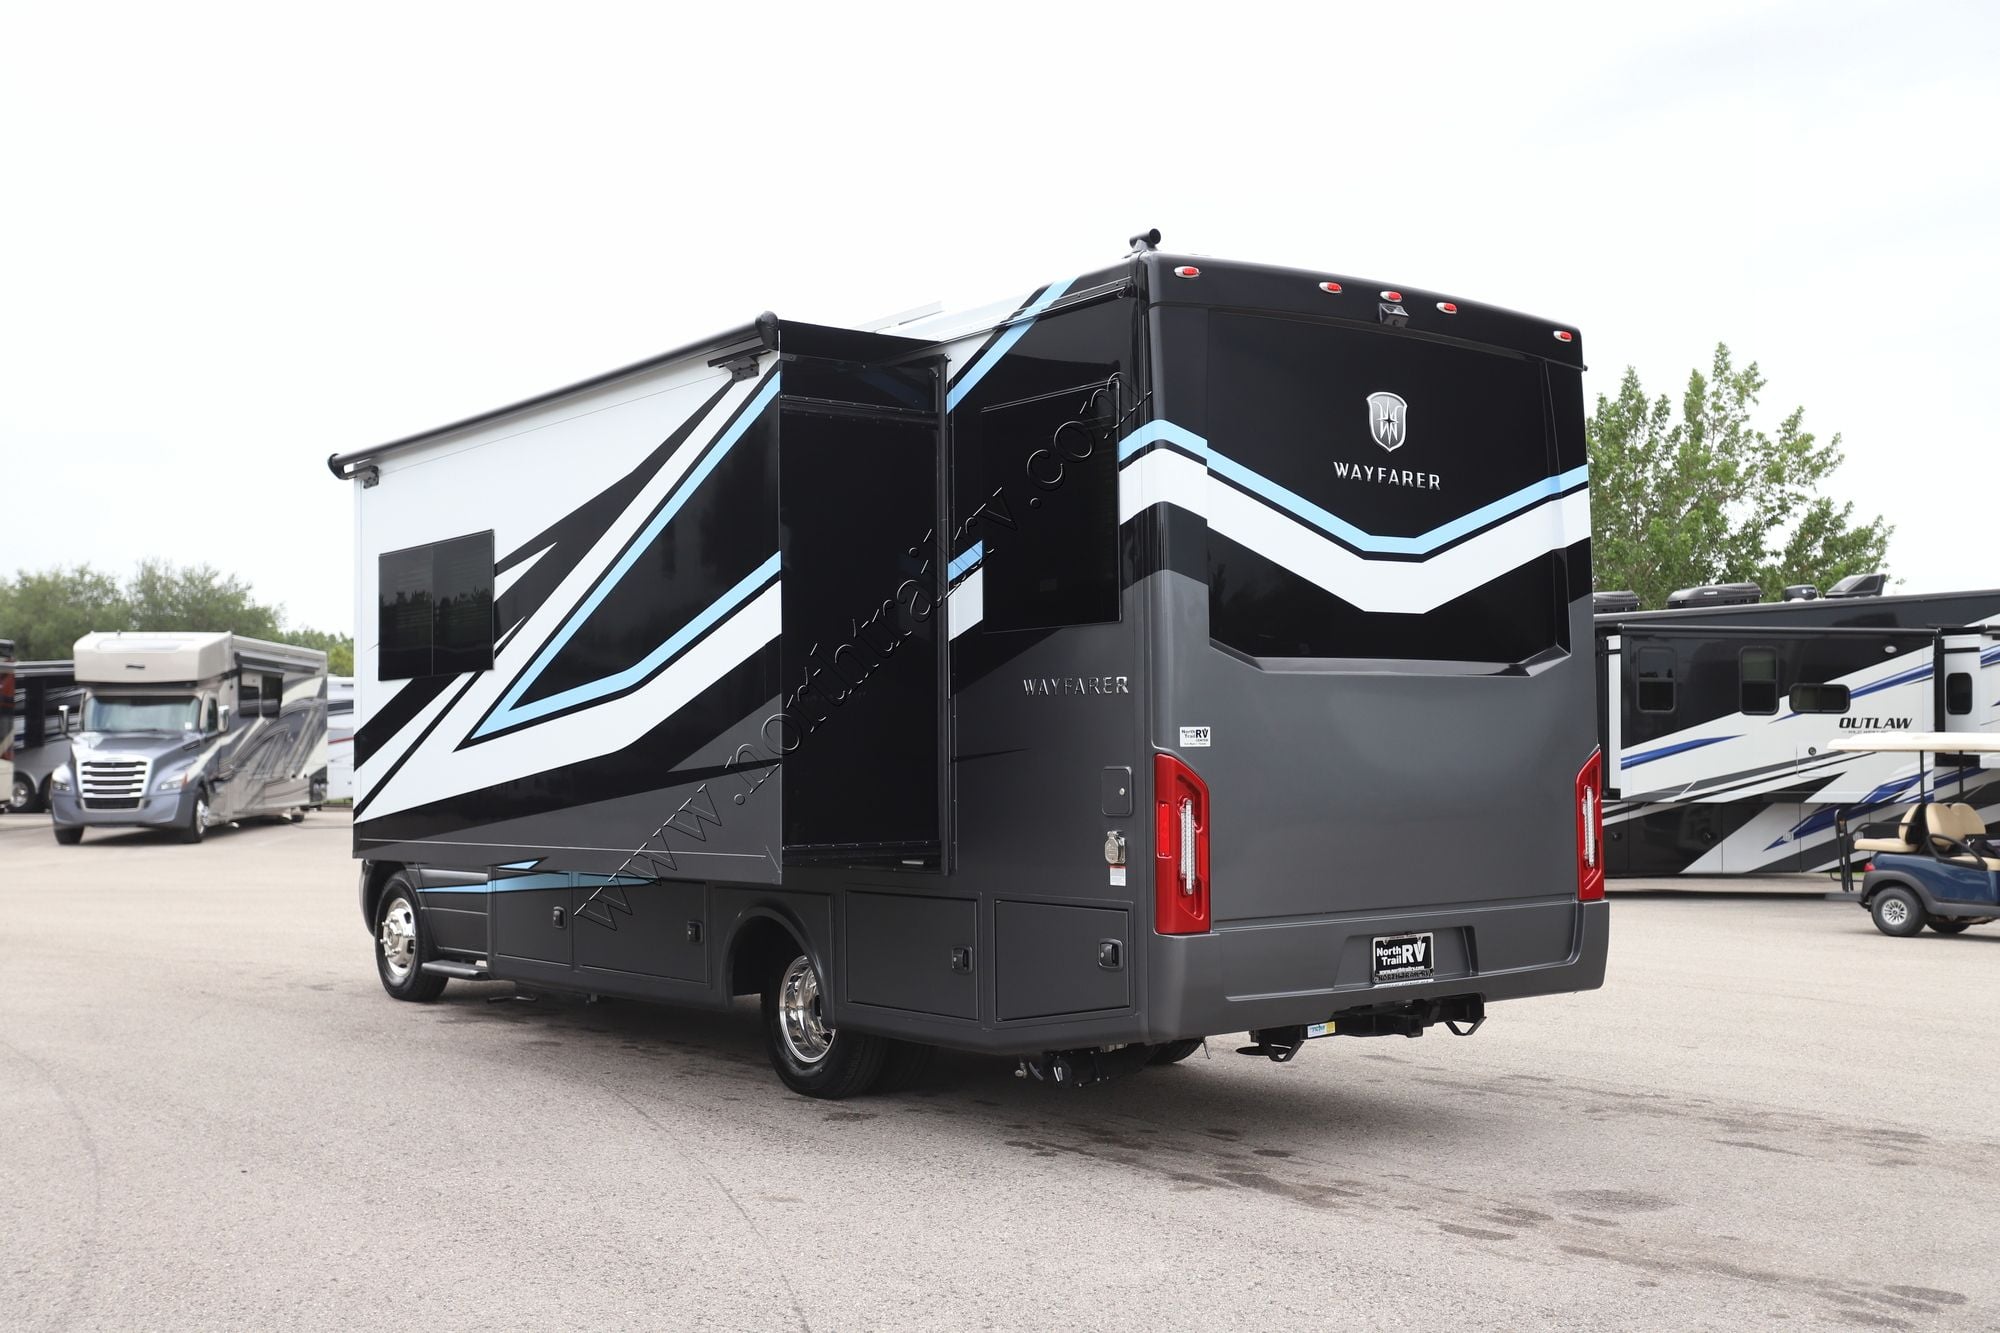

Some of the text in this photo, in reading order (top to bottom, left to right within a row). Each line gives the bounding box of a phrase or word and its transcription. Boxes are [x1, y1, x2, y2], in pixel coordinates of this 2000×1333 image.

[1333, 461, 1441, 491] WAYFARER
[1023, 676, 1129, 696] WAYFARER
[1838, 717, 1913, 729] OUTLAW
[1196, 728, 1208, 738] RV
[1376, 941, 1427, 964] North RV
[1381, 955, 1402, 966] Trail
